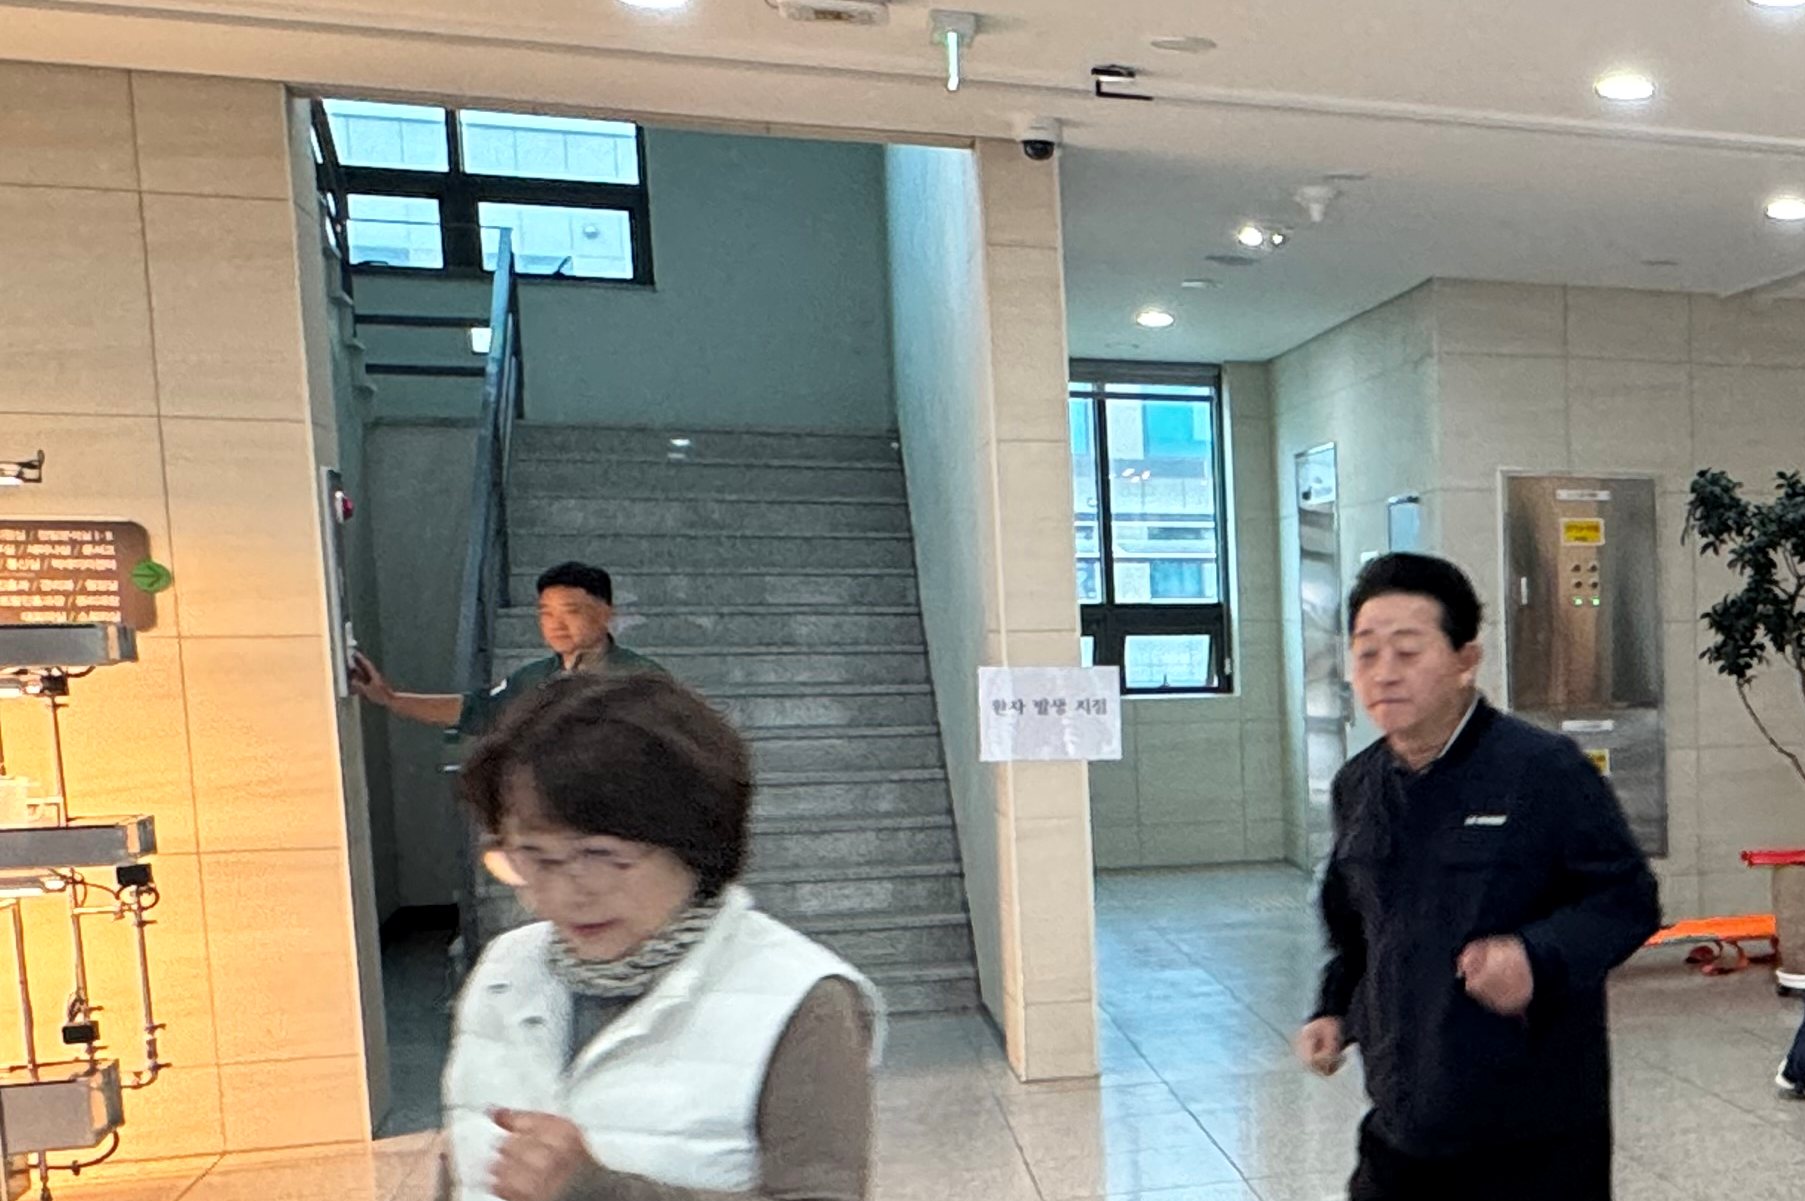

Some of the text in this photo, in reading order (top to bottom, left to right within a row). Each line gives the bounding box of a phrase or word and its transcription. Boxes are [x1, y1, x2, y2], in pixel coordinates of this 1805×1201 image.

[992, 698, 1108, 716] 환자 발생 지점
